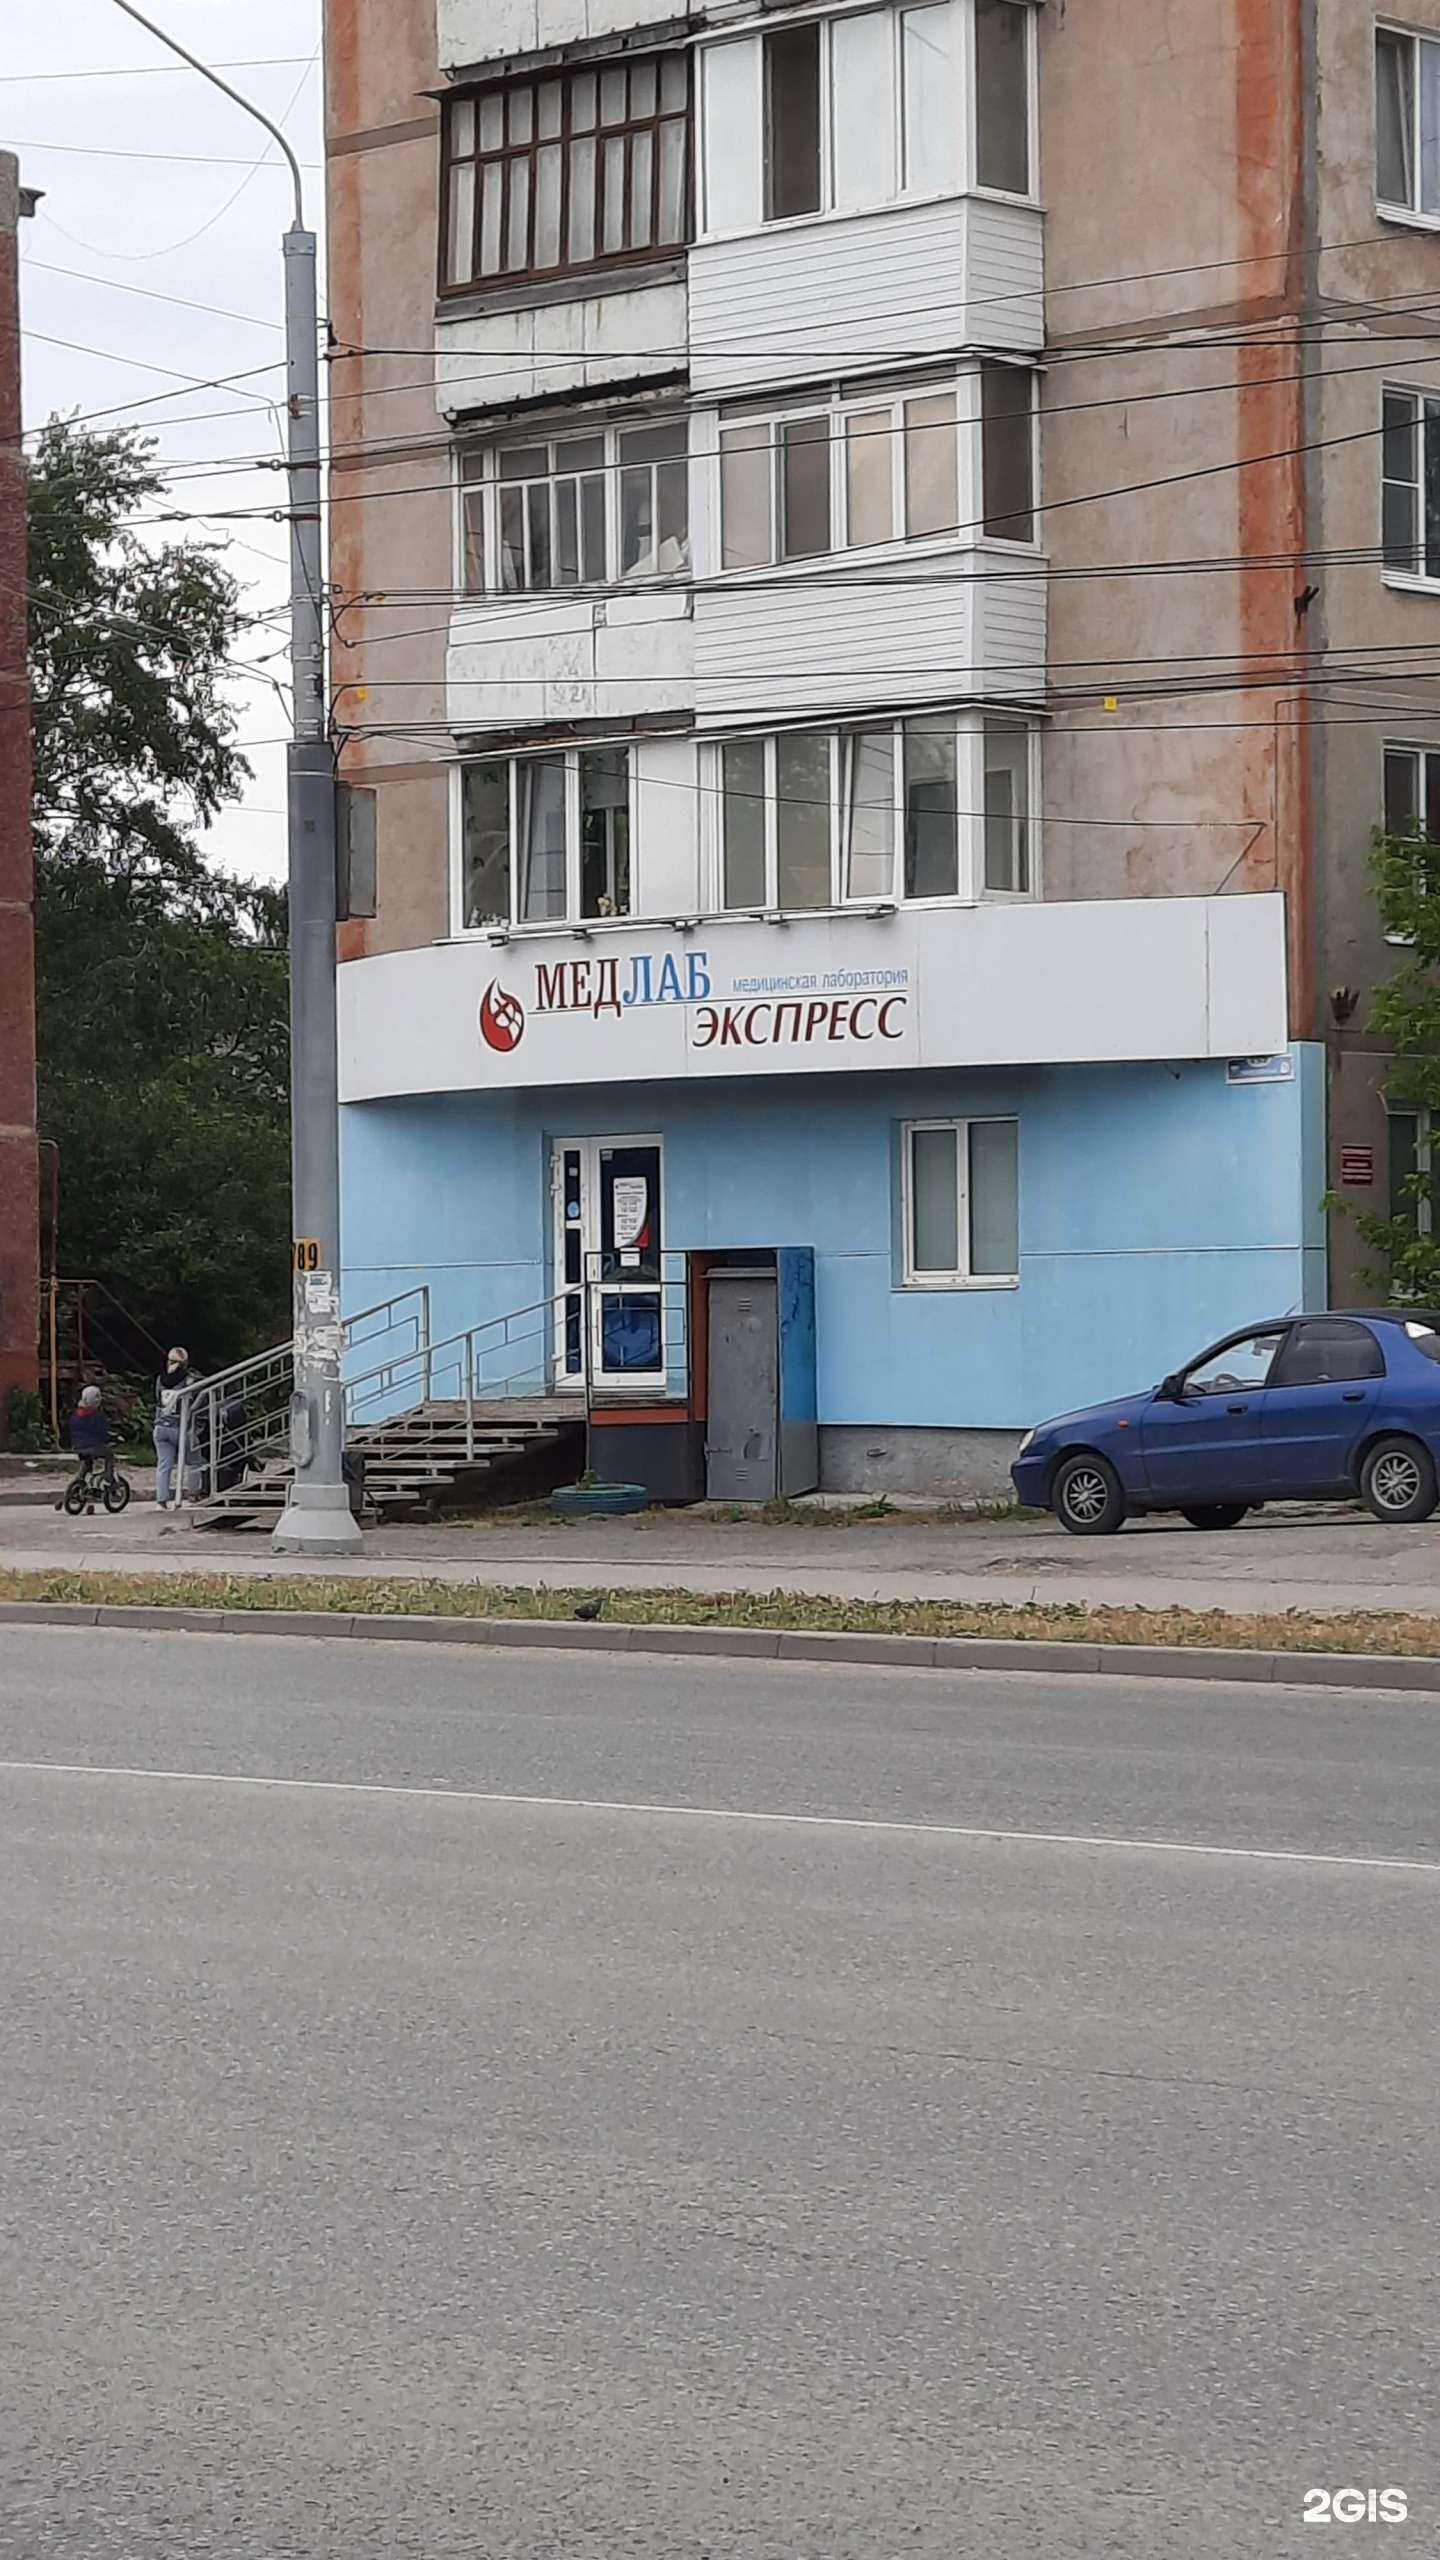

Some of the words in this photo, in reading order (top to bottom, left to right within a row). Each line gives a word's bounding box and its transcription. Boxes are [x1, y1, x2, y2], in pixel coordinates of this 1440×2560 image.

[534, 952, 711, 1019] МЕДЛАБ
[732, 976, 817, 993] медицинская
[821, 968, 908, 990] лаборатория
[692, 997, 908, 1047] ЭКСПРЕСС
